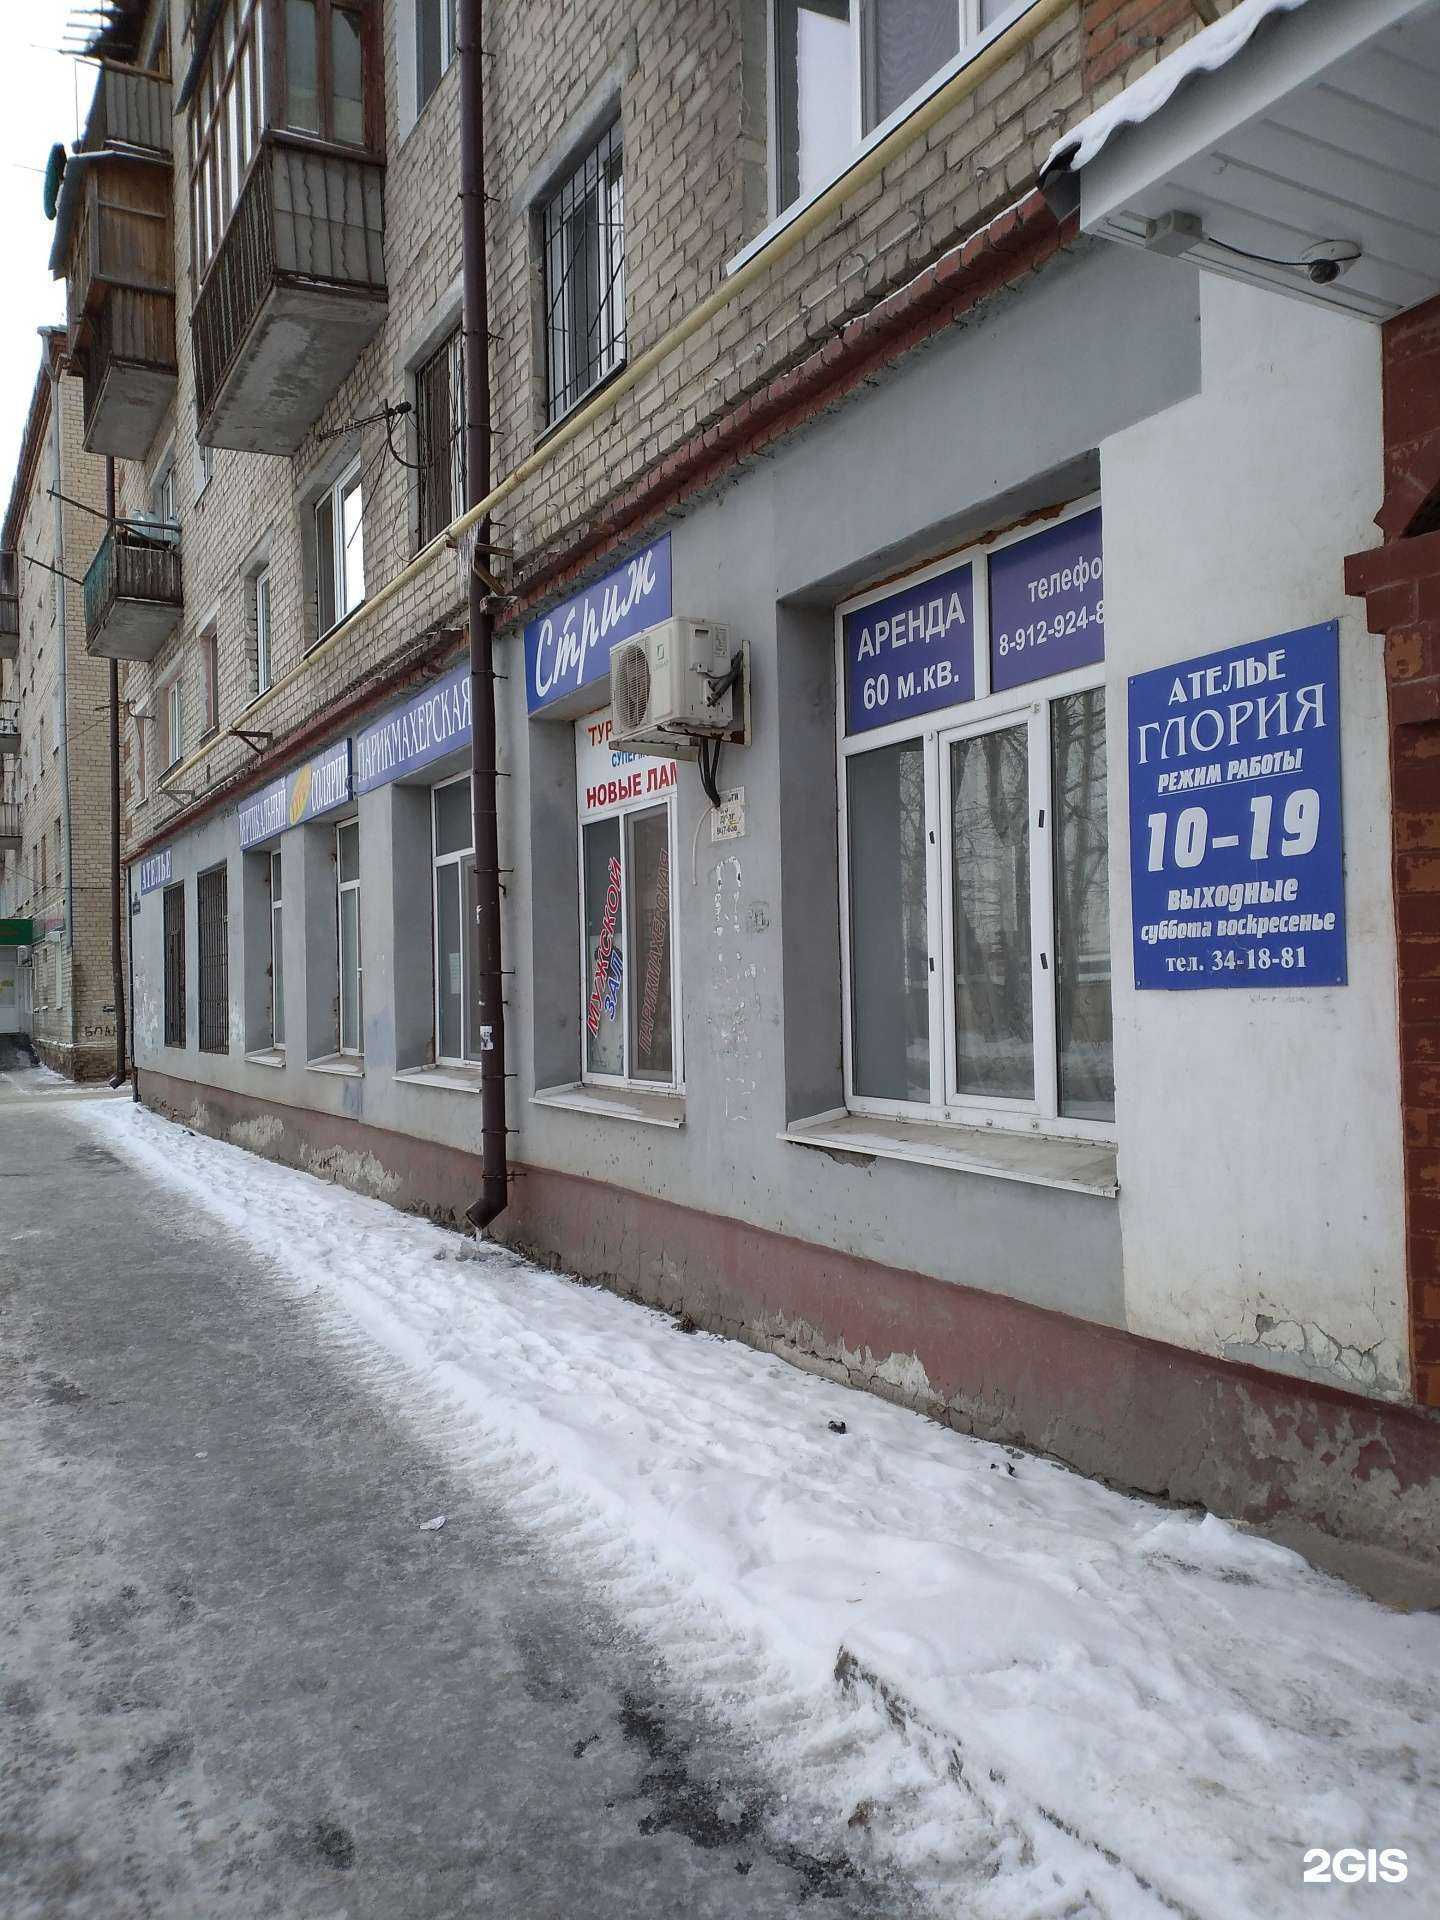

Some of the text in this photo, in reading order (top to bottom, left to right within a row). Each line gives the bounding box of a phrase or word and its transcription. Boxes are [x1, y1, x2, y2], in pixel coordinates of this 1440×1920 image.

[1028, 556, 1103, 602] телефо
[536, 550, 656, 697] Стриж
[857, 592, 966, 662] АРЕНДА
[999, 600, 1104, 656] 8-912-924-8
[863, 660, 960, 710] 60 м.кв.
[1168, 649, 1286, 706] АТЕЛЬЕ
[358, 677, 472, 782] ПАРИКМАХЕРСКАЯ
[1137, 683, 1326, 764] ГЛОРИЯ
[587, 773, 642, 808] НОВЫЕ
[1158, 748, 1303, 793] РЕЖИМ РАБОТЫ
[1148, 788, 1320, 872] 10-19
[142, 850, 171, 890] АТЕЛЬЕ
[587, 856, 622, 1038] МУЖСКОЙ
[639, 848, 670, 1056] ПАРИКМАХЕРСКАЯ
[1141, 911, 1335, 945] суббота воскресенье
[603, 950, 624, 1022] ЗАЛ
[1166, 947, 1306, 972] тел. 34-18-81
